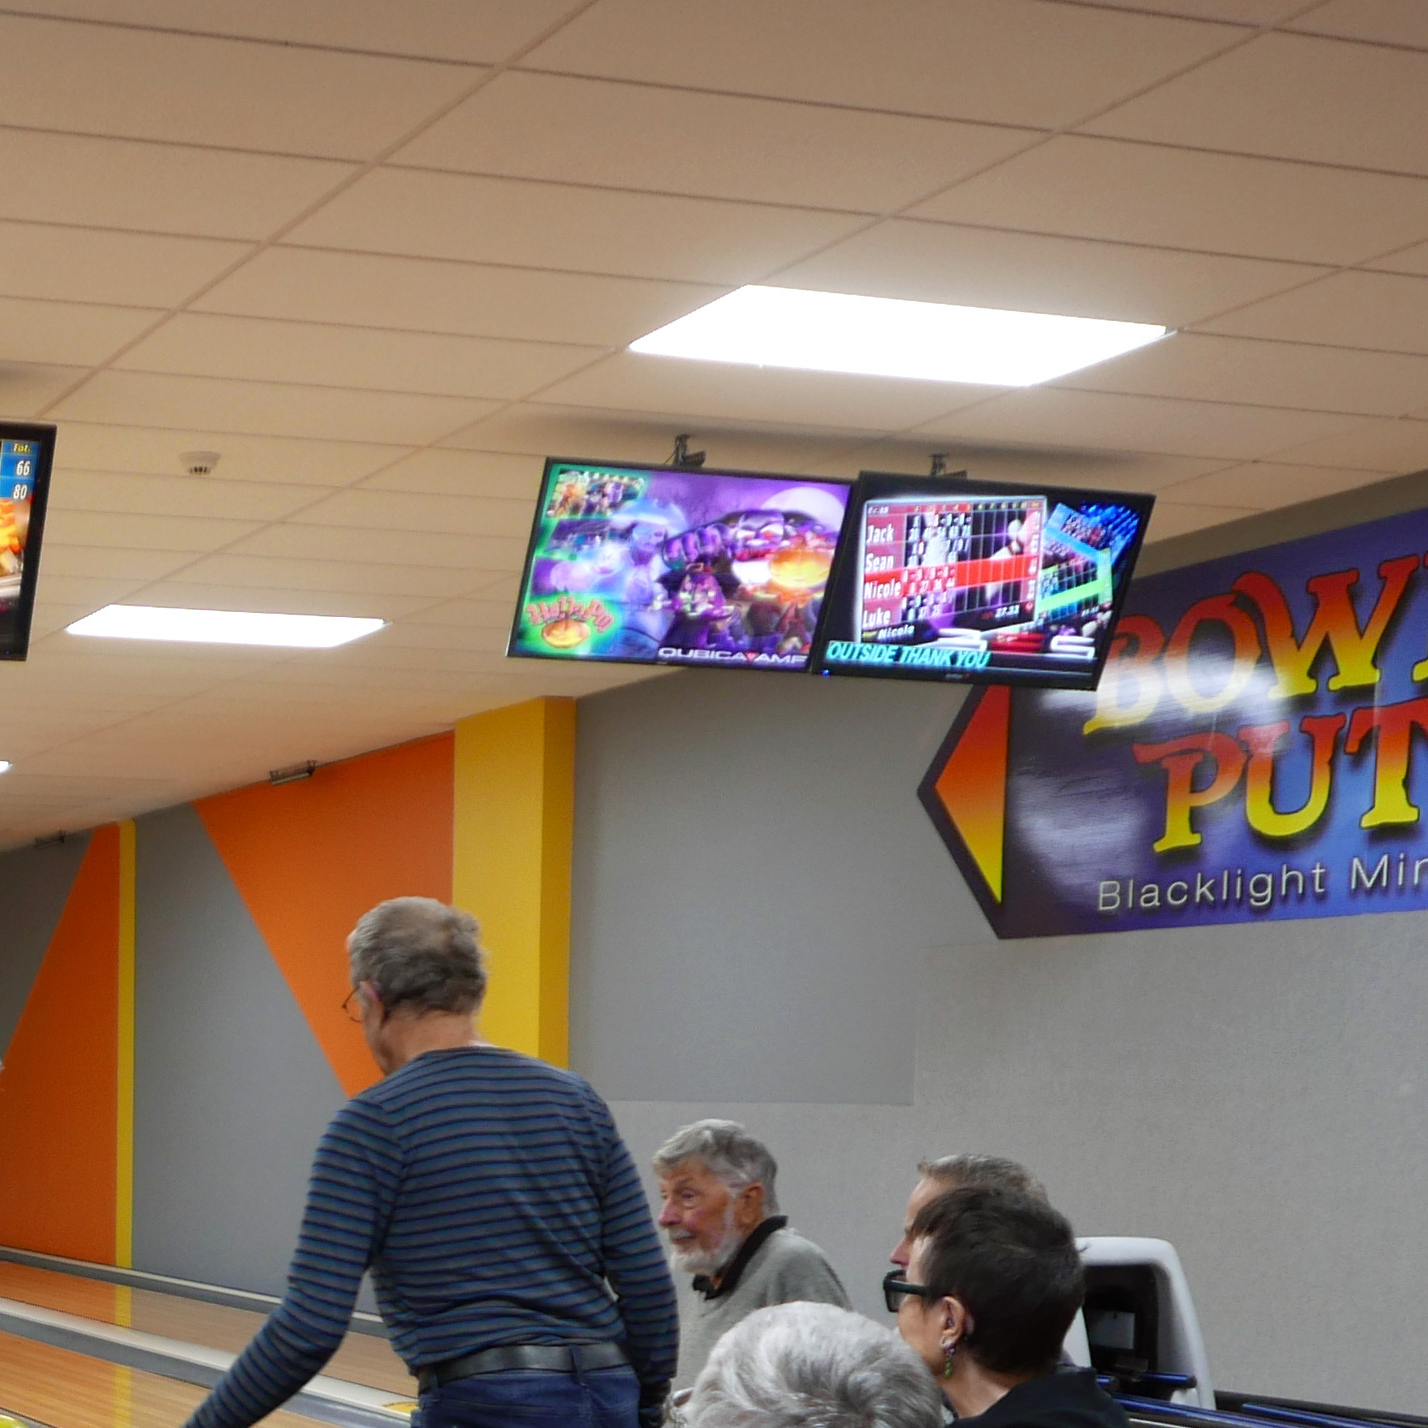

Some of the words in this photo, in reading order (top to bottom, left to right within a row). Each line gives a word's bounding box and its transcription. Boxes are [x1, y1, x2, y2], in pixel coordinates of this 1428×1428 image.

[16, 461, 30, 476] 66
[14, 484, 27, 499] 80
[866, 523, 895, 544] Jack
[866, 553, 895, 572] Sean
[864, 579, 902, 599] Nicole
[863, 609, 891, 632] Luke
[878, 624, 915, 641] Nicole
[1083, 553, 1428, 735] BOW
[658, 647, 746, 662] QUBICA
[752, 651, 808, 665] AMF
[827, 641, 898, 664] OUTSIDE
[900, 644, 956, 667] THANK
[956, 649, 992, 668] YOU
[1098, 862, 1326, 911] Blacklight
